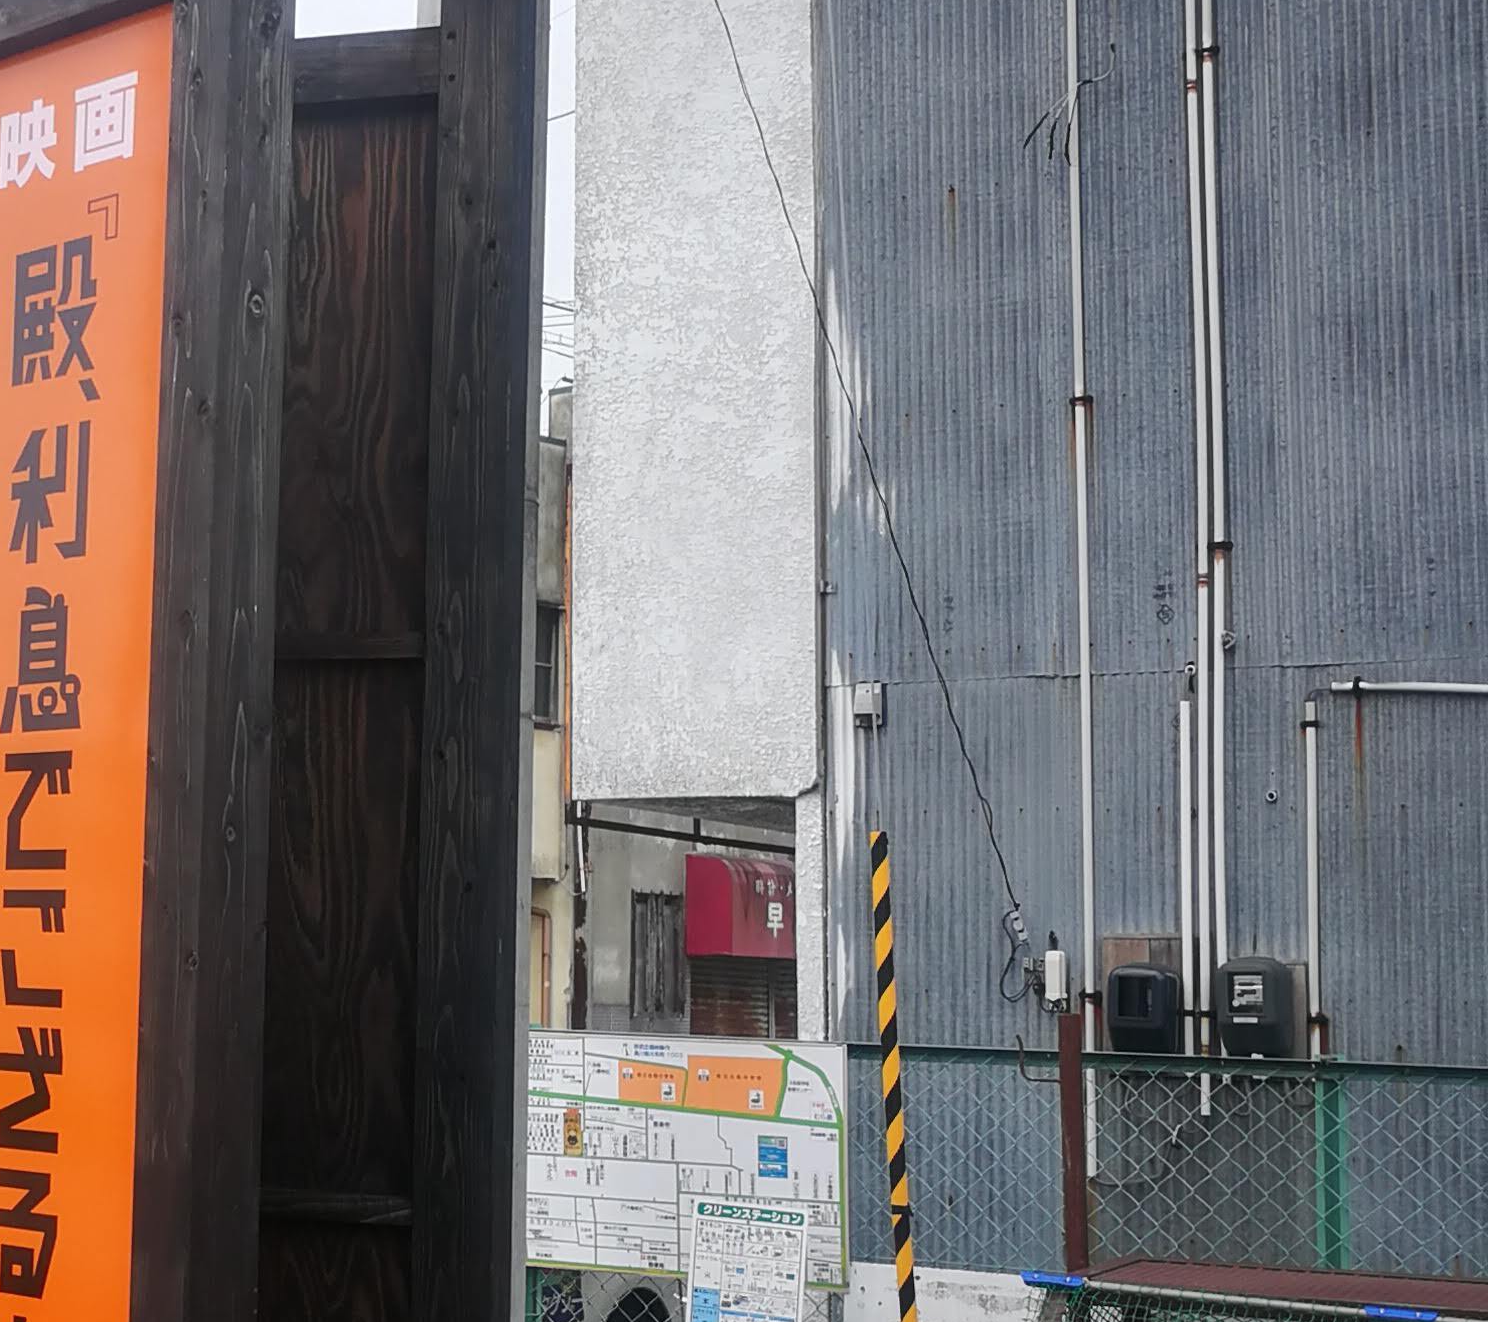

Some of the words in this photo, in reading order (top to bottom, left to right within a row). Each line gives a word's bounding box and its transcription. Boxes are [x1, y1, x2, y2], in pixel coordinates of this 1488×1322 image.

[703, 1204, 802, 1224] クリーンステーション
